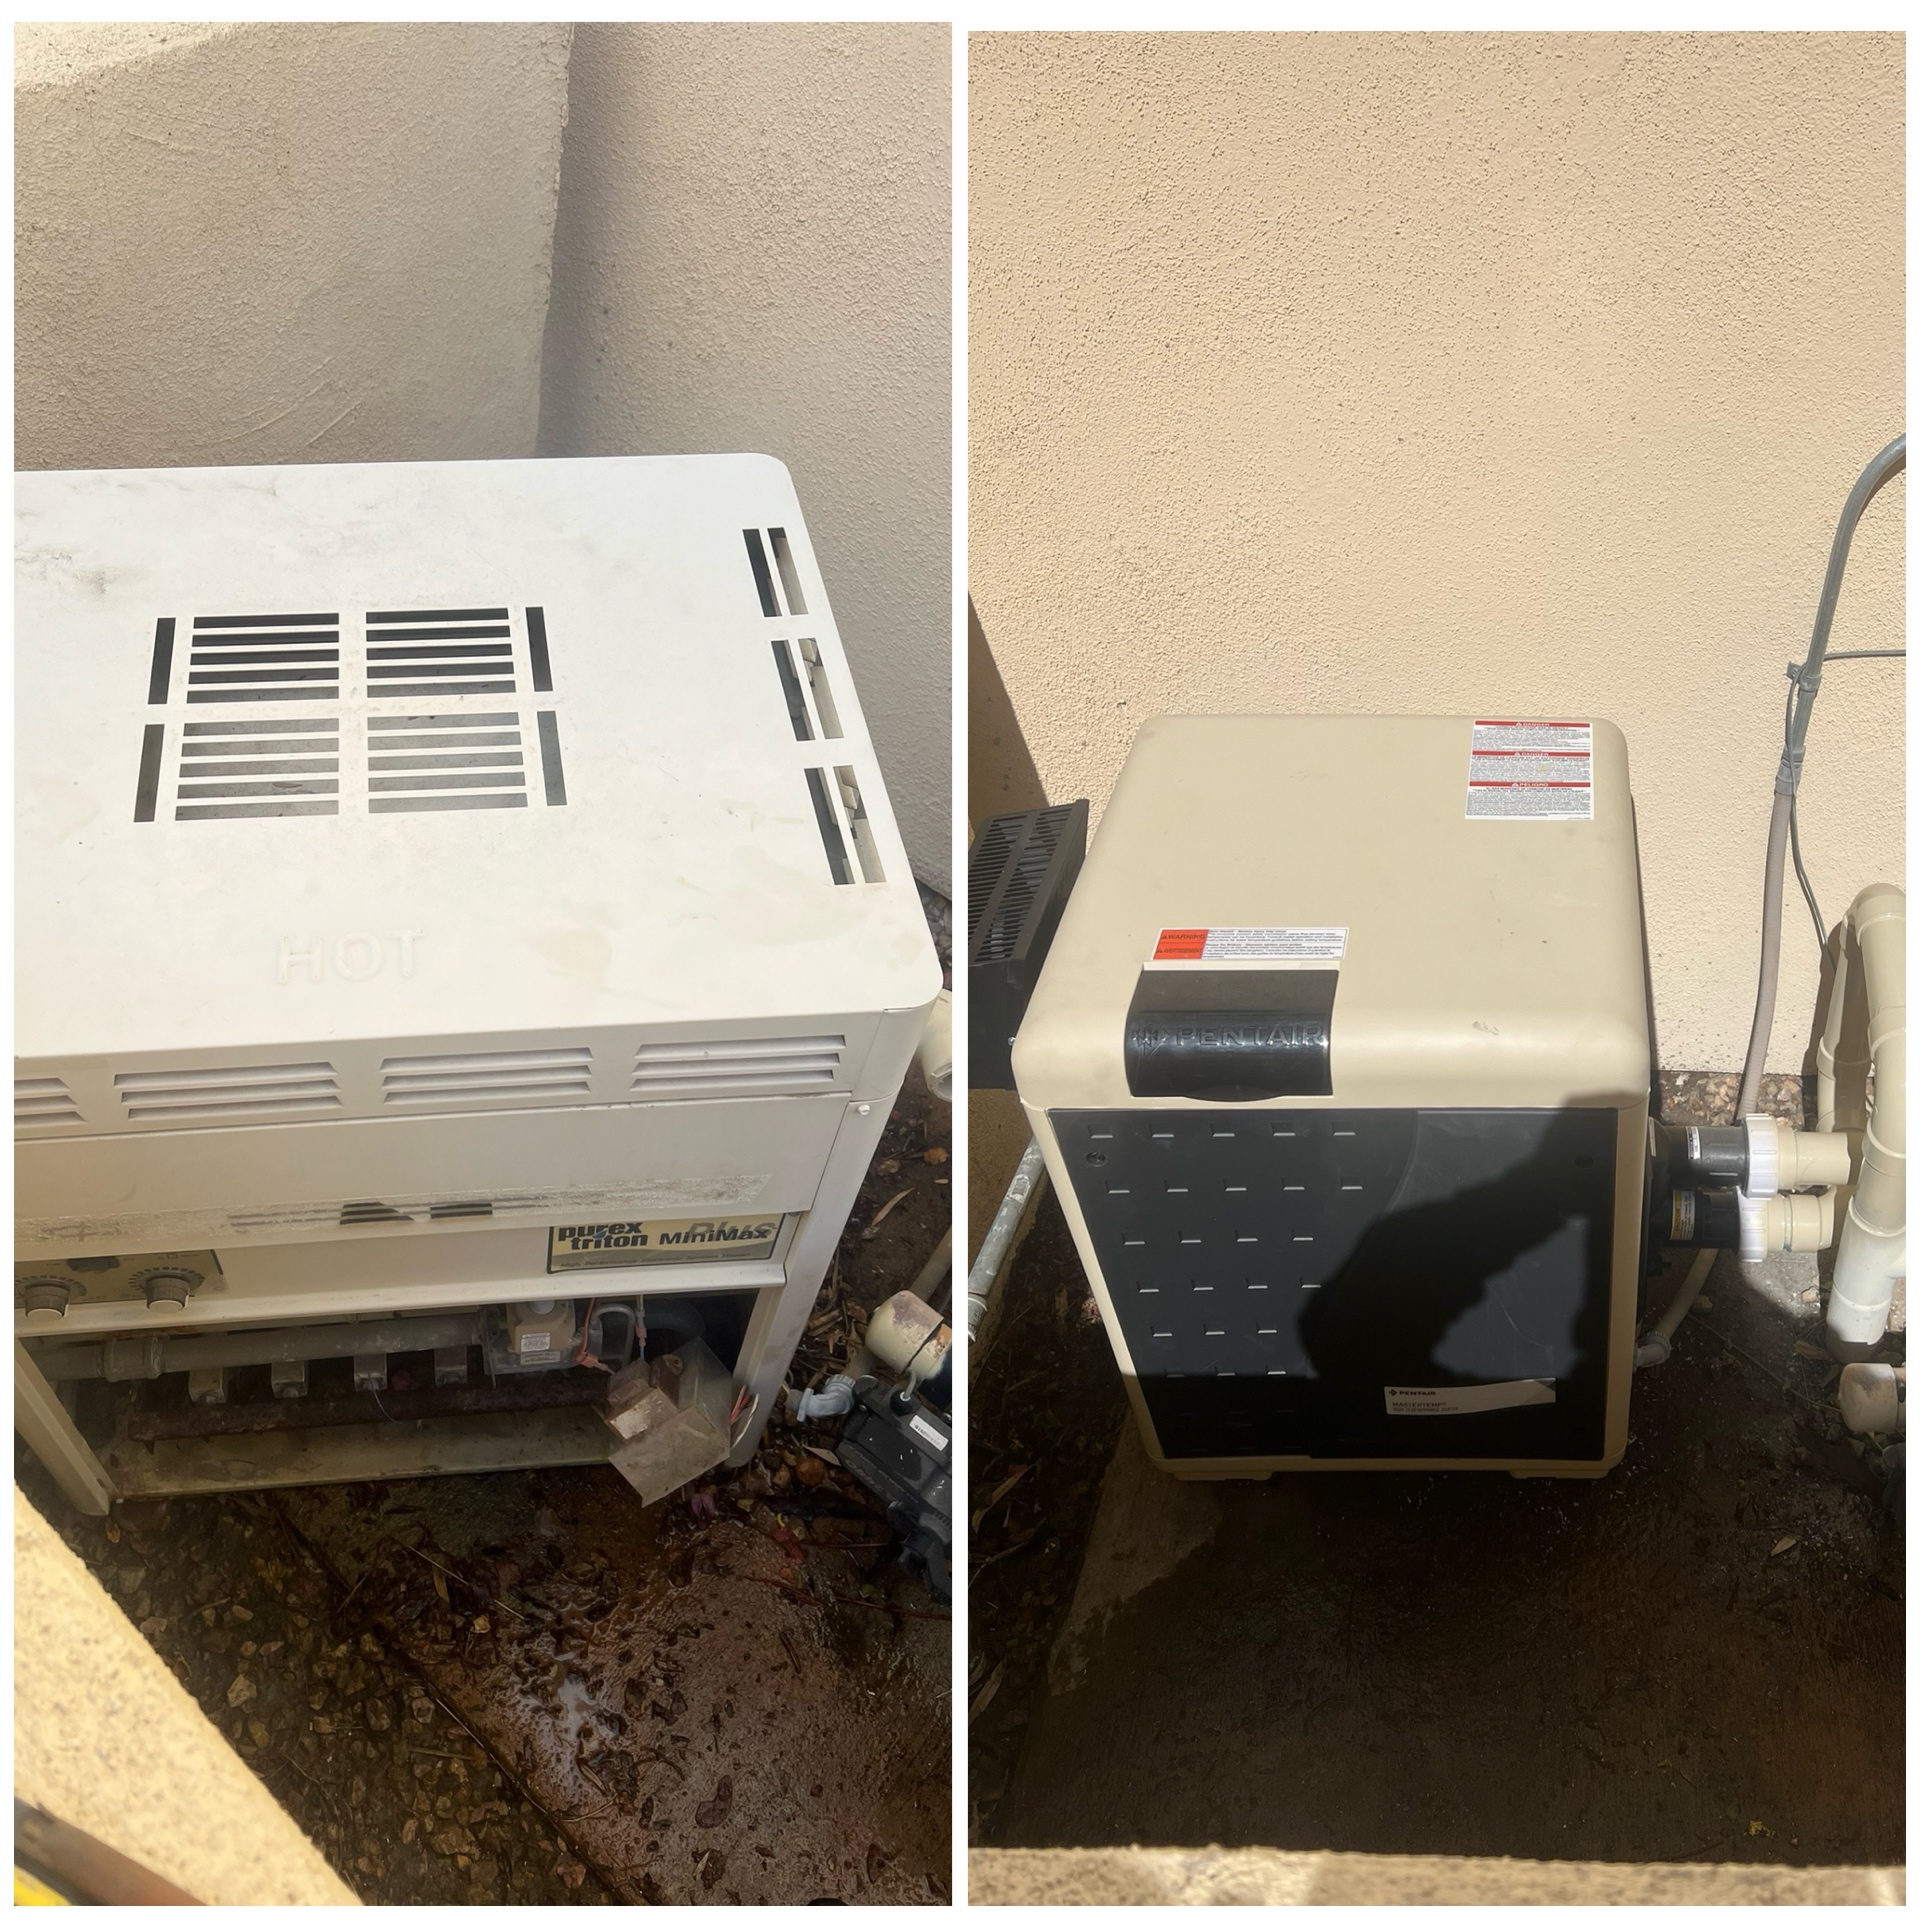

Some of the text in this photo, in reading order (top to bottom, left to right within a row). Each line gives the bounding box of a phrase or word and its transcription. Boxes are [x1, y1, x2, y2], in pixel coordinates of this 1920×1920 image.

[275, 928, 427, 985] HOT
[1176, 1024, 1324, 1047] PENTAIR
[558, 1222, 643, 1241] purex
[659, 1228, 770, 1244] MiniMax
[571, 1235, 648, 1250] triton
